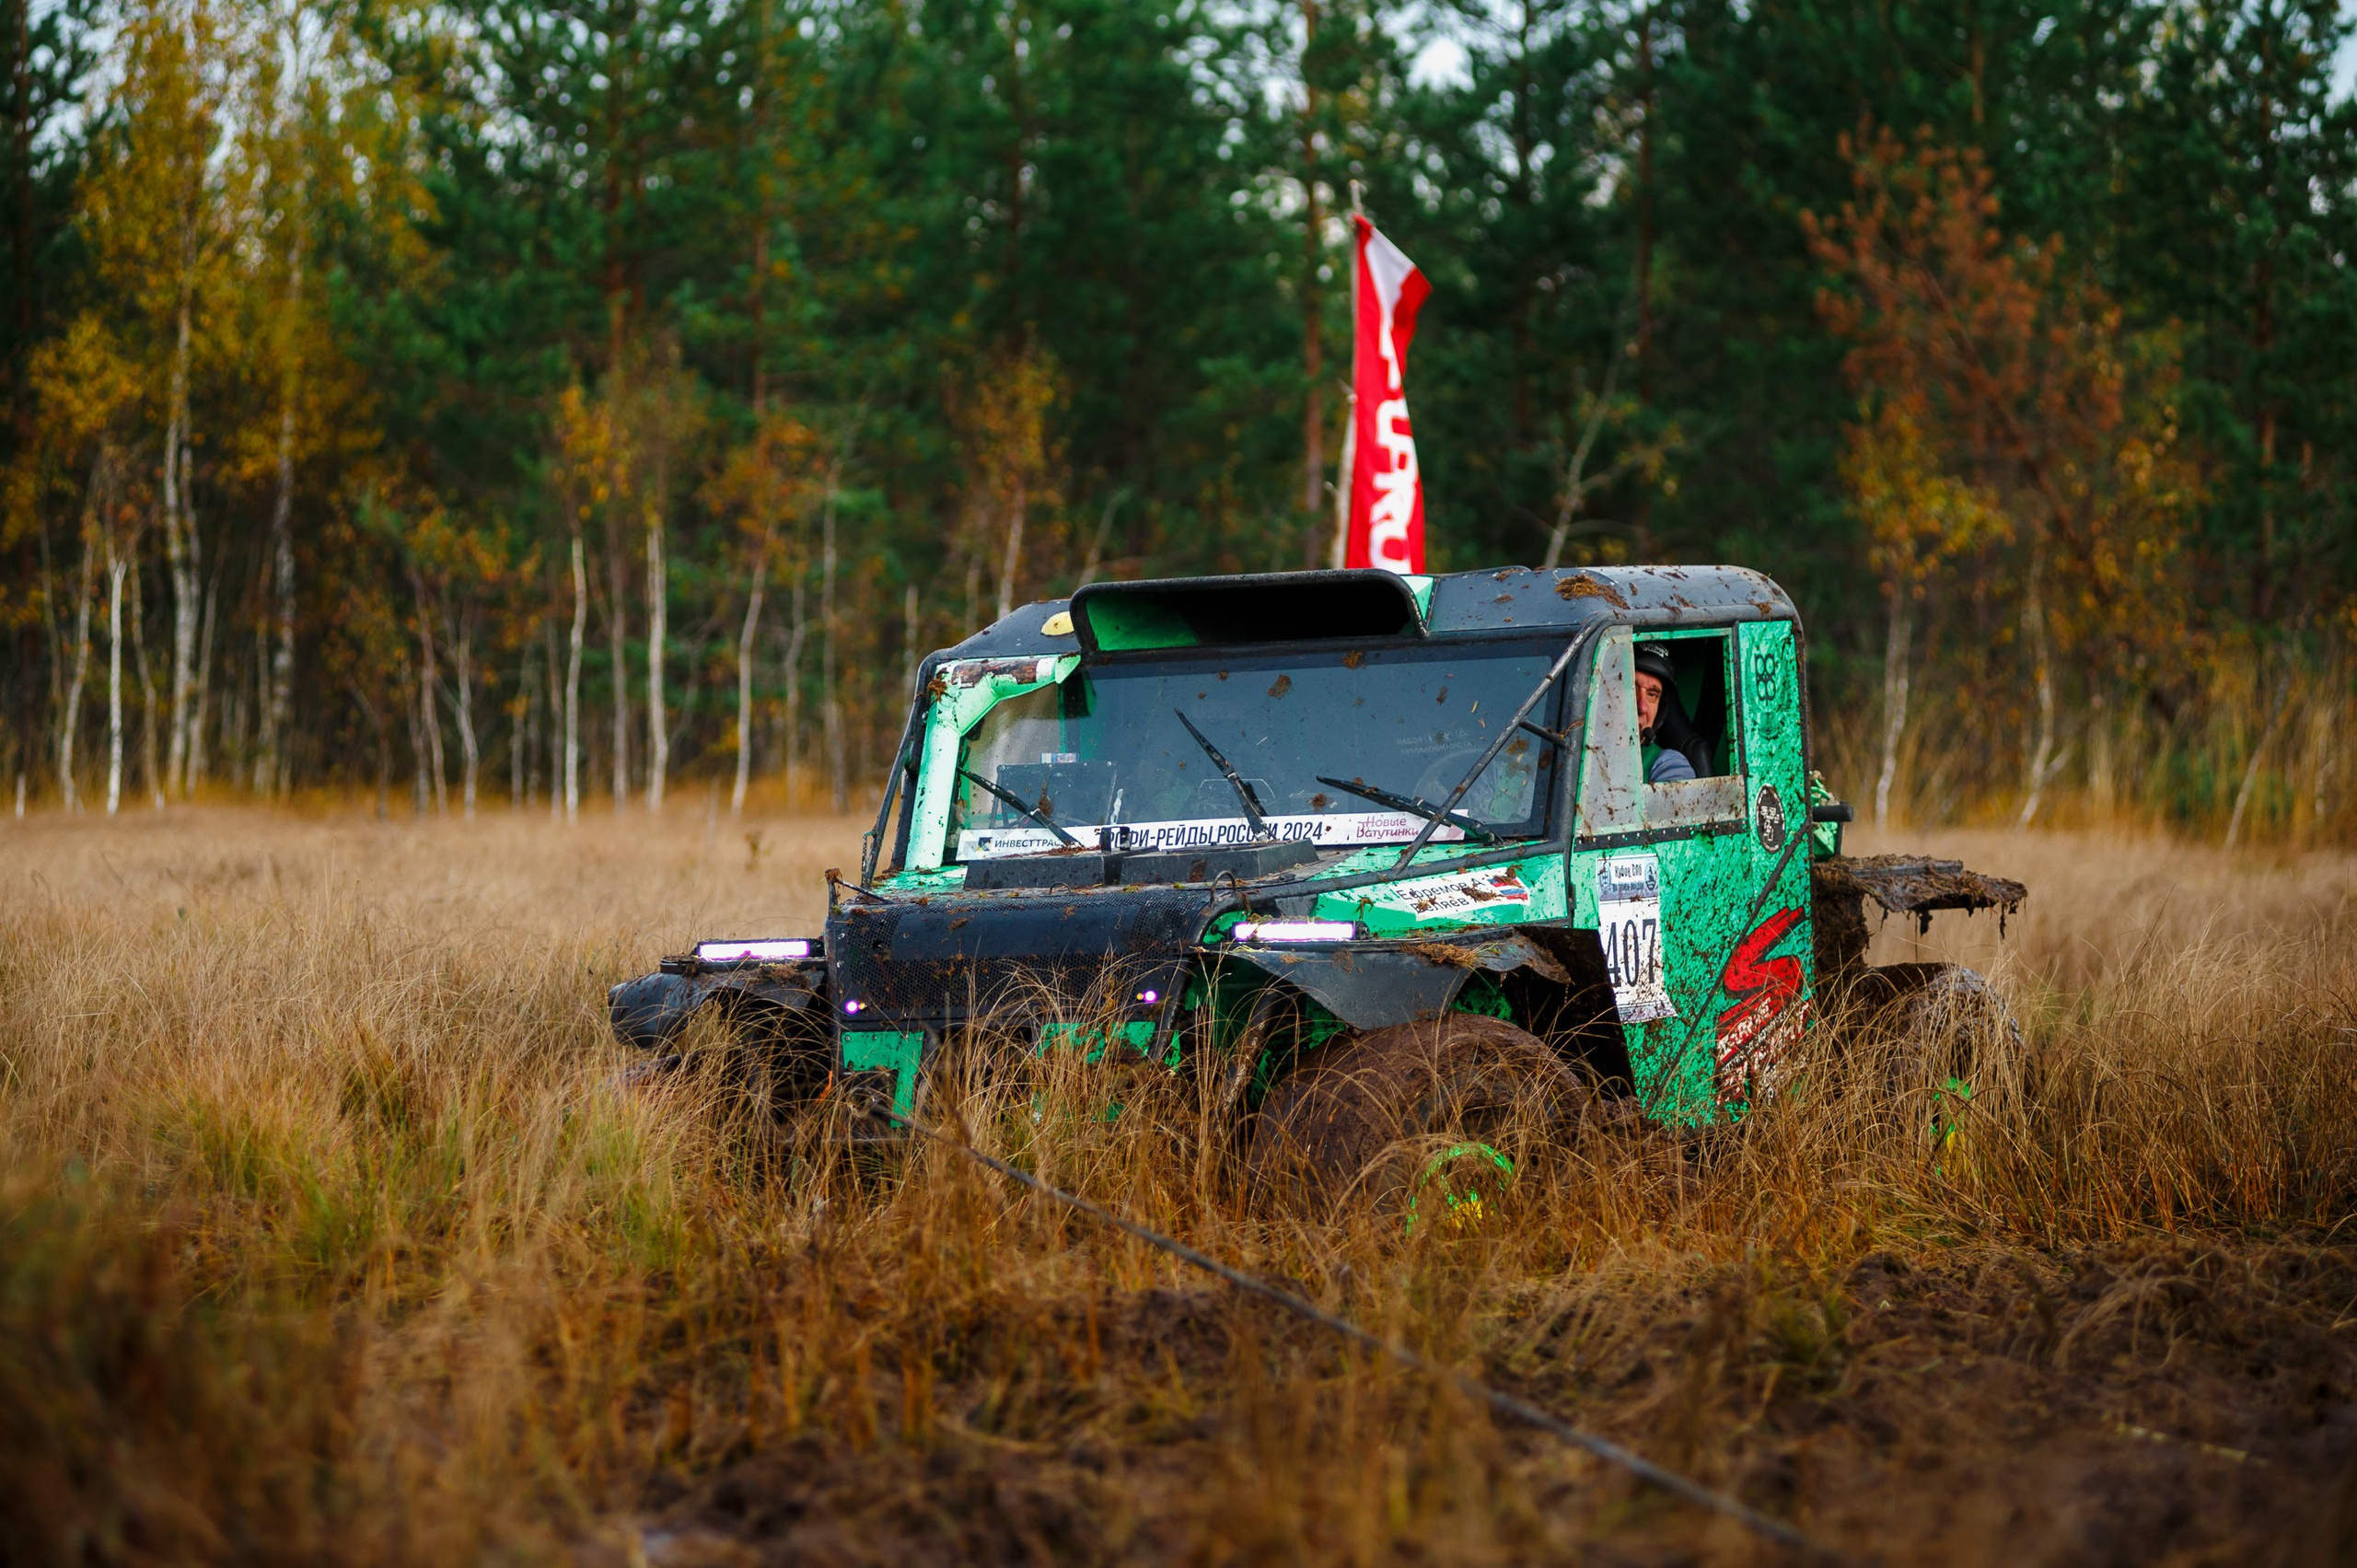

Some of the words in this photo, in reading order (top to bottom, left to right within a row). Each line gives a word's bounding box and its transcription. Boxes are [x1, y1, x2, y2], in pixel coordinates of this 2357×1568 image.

[1357, 816, 1407, 828] Новые
[1098, 824, 1213, 848] ОФИ-РЕЙДЫ
[1215, 822, 1278, 844] РОССИ
[1282, 821, 1323, 842] 2024
[1396, 881, 1469, 901] Ефремов
[1607, 917, 1657, 988] 407
